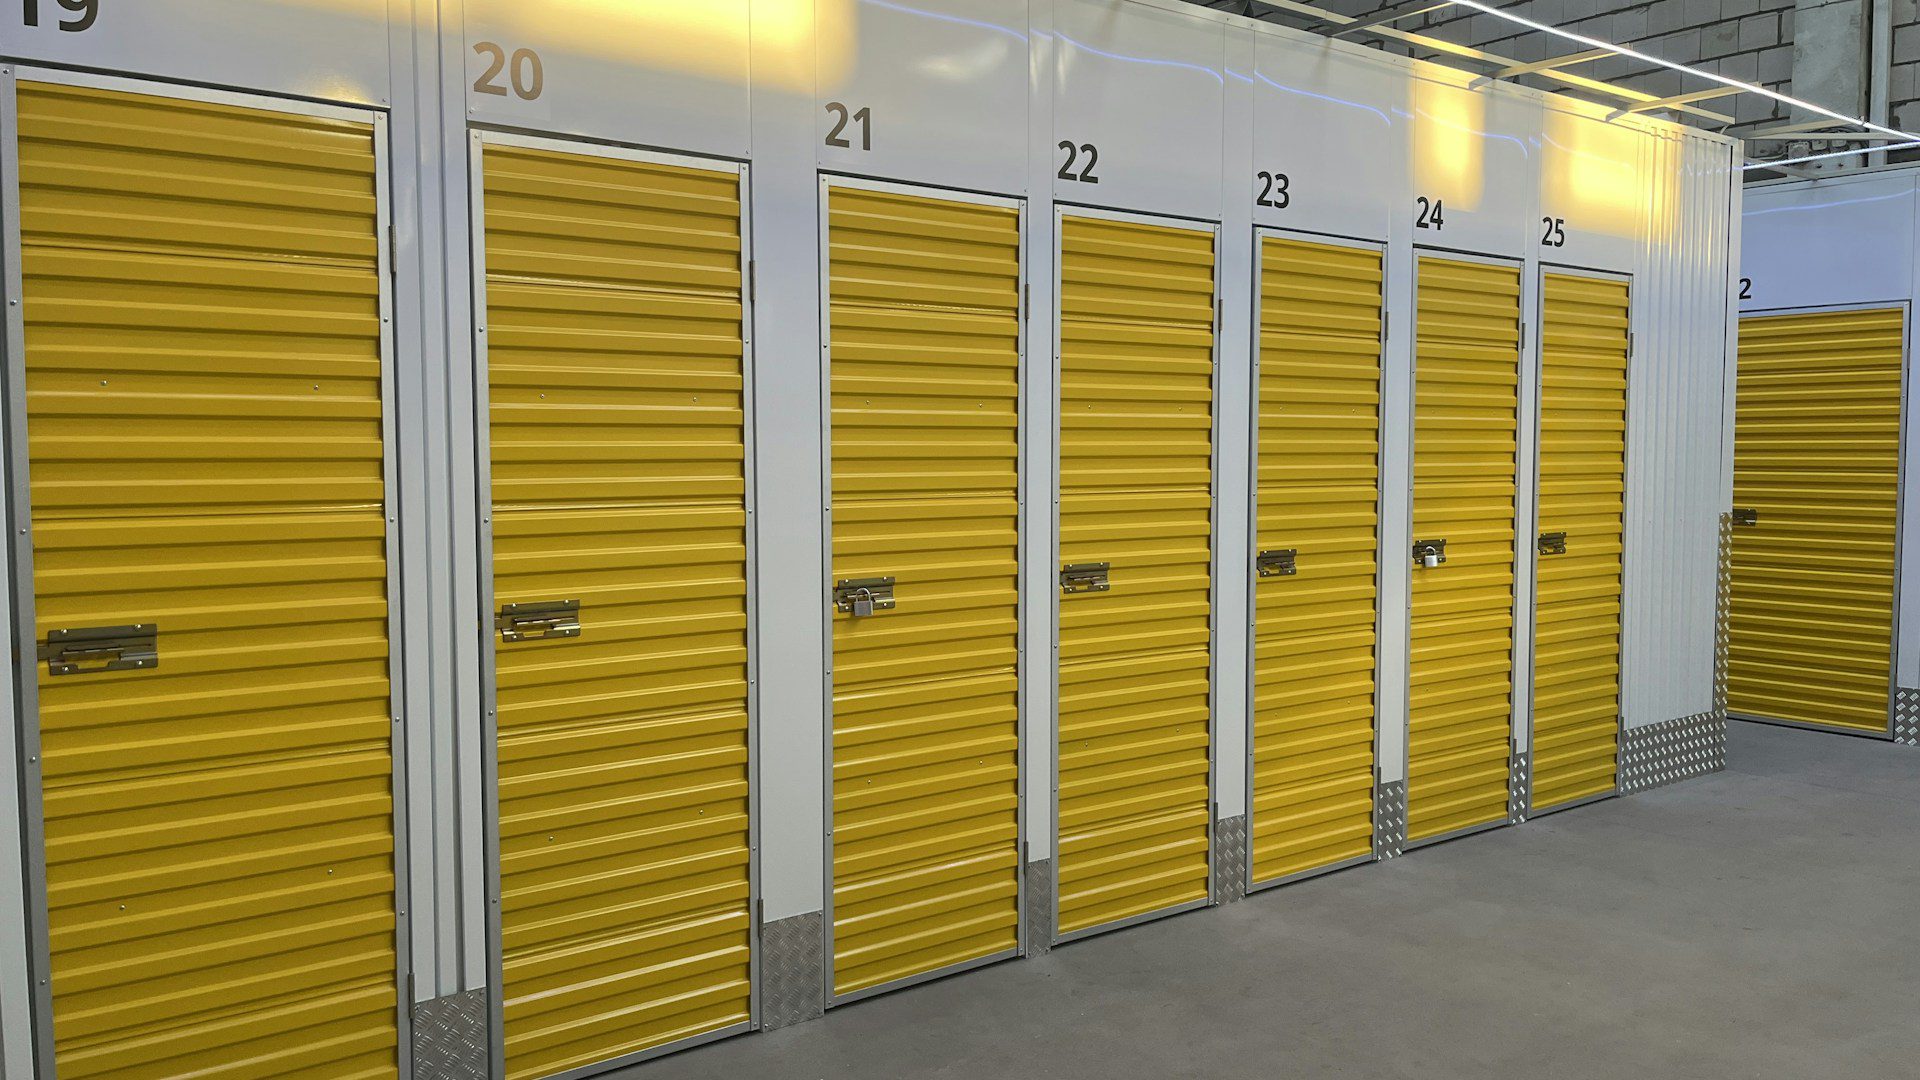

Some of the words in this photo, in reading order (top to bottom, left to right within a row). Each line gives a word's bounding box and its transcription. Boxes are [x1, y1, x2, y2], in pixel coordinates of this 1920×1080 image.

[473, 42, 543, 101] 20
[825, 101, 871, 151] 21
[1057, 141, 1099, 184] 22
[1256, 171, 1290, 209] 23
[1416, 196, 1444, 231] 24
[1541, 216, 1565, 248] 25
